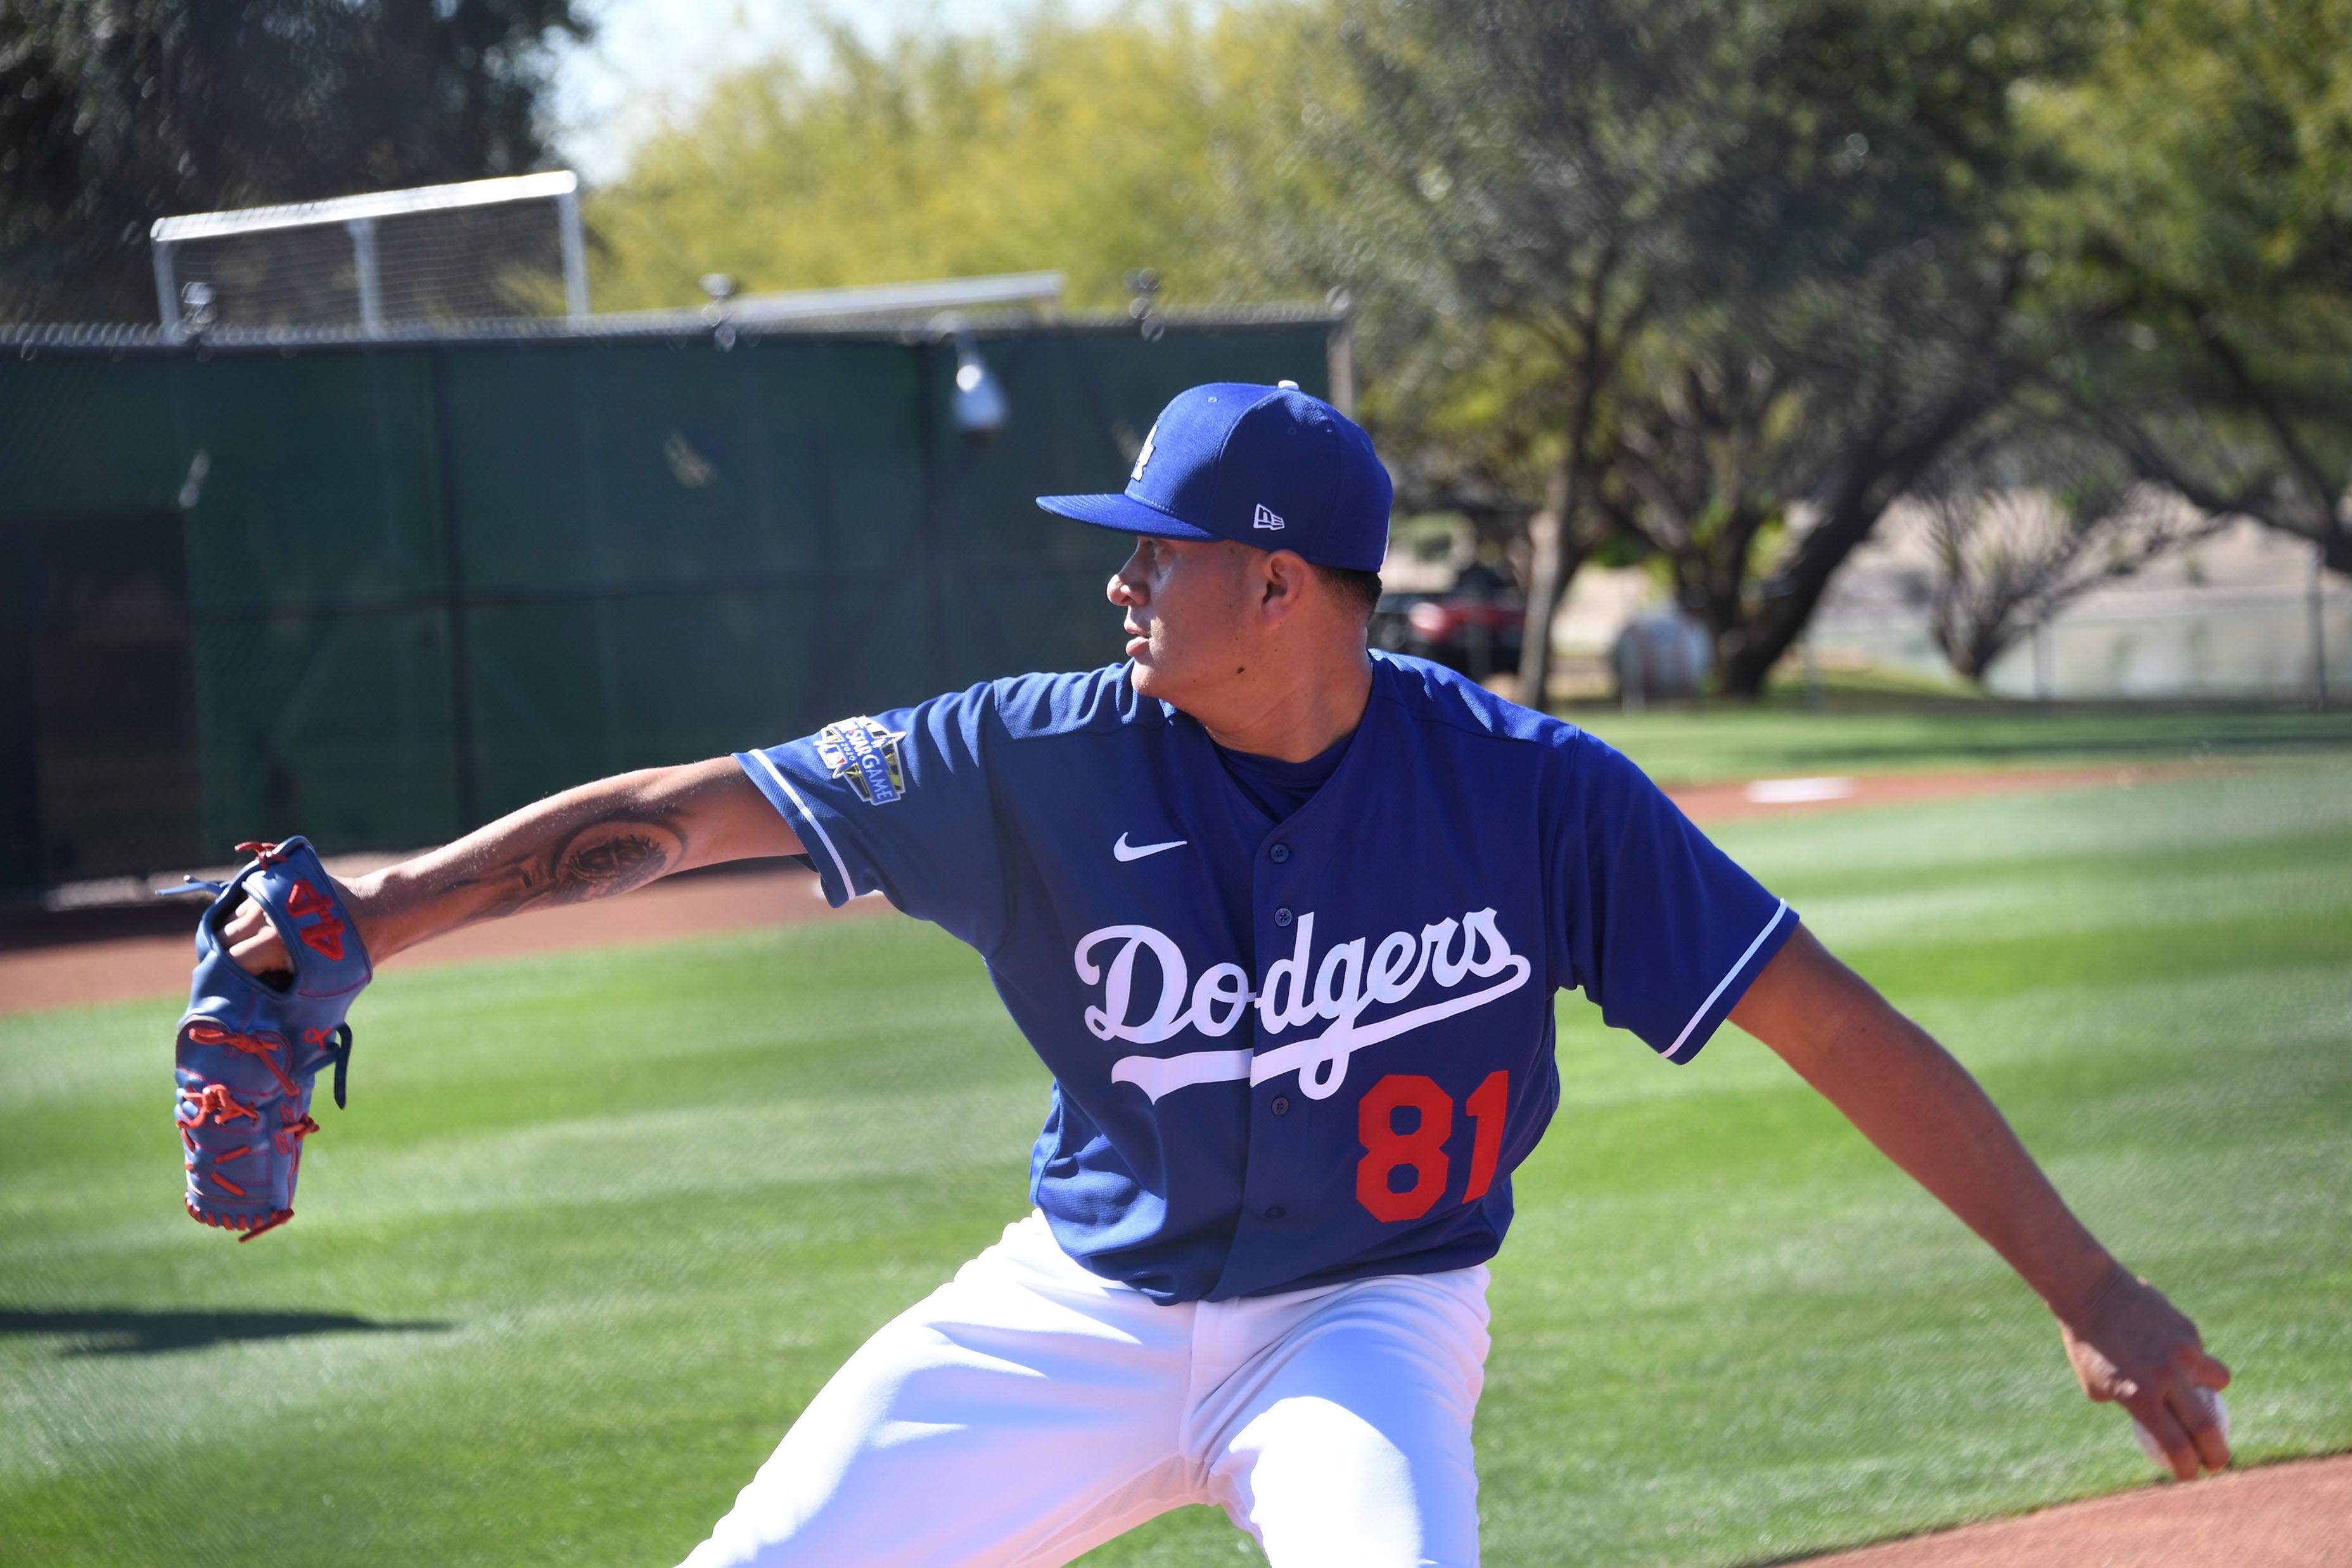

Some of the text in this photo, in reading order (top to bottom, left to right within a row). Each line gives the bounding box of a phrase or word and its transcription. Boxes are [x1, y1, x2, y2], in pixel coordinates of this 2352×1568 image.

[862, 754, 893, 800] GAME
[1075, 907, 1531, 1100] Dodgers
[1356, 1070, 1509, 1223] 81
